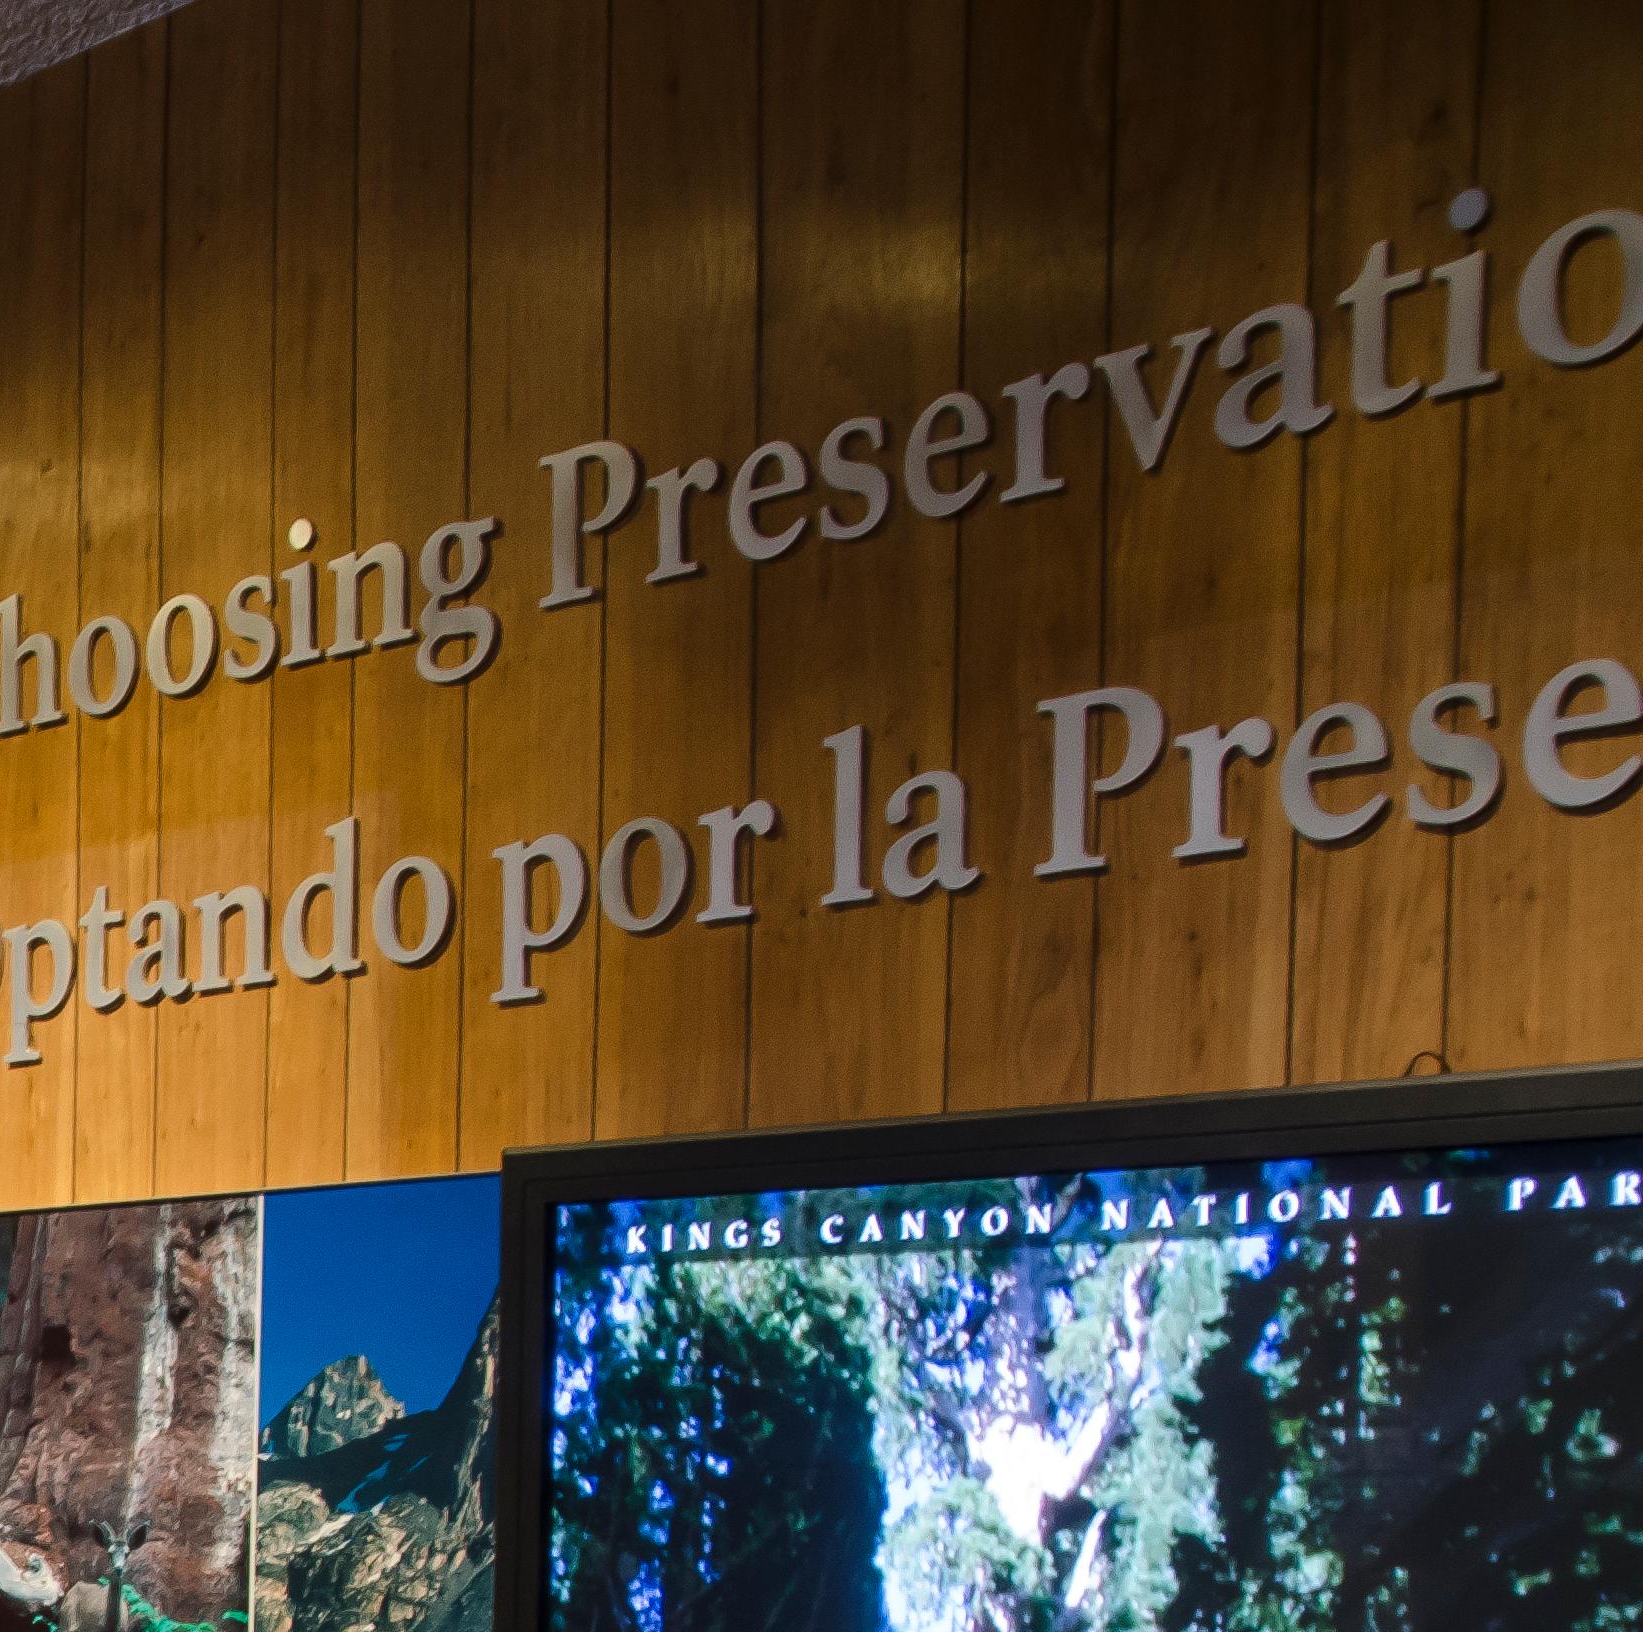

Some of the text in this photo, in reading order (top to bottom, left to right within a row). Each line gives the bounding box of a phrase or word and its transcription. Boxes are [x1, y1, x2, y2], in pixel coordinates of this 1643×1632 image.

[537, 187, 1643, 611] Preservatio
[491, 798, 776, 1003] por
[821, 725, 980, 908] la
[1033, 658, 1643, 877] Prese
[626, 1170, 1642, 1254] KINGS CANYON NATIONAL PAR
